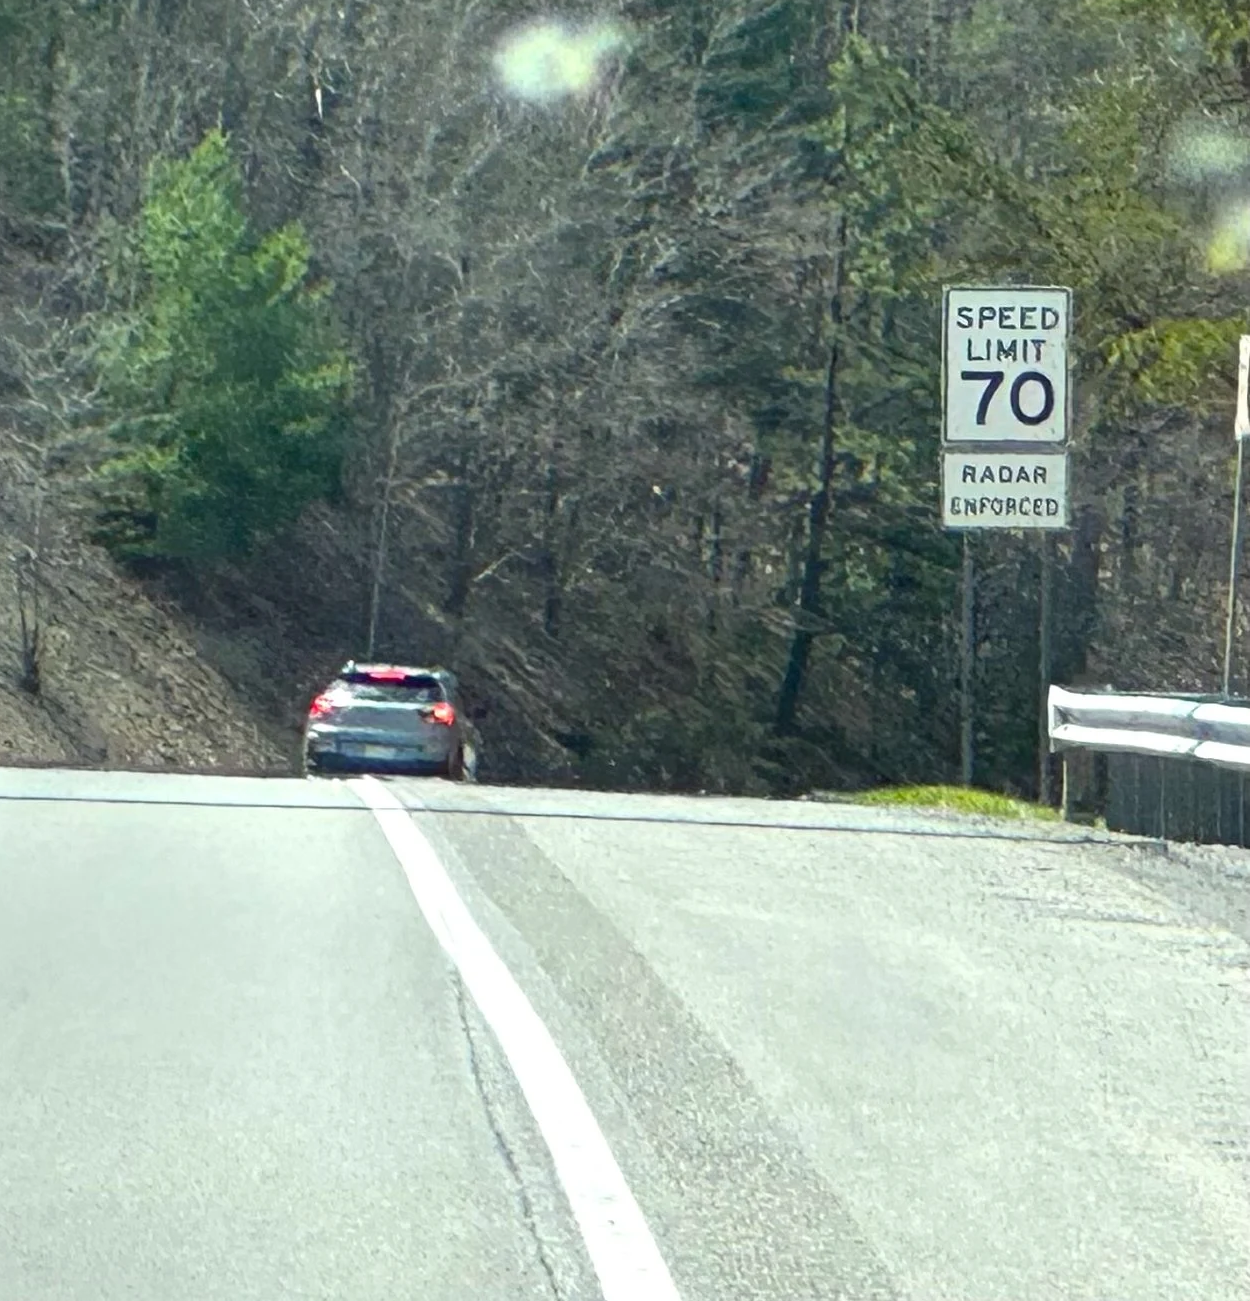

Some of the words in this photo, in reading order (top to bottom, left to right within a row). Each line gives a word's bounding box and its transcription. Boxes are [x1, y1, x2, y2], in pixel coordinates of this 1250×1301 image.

[956, 305, 1059, 330] SPEED
[967, 338, 1046, 362] LIMIT
[960, 371, 1055, 426] 70
[962, 465, 1047, 484] RADAR
[950, 497, 1059, 517] ENFORCED
